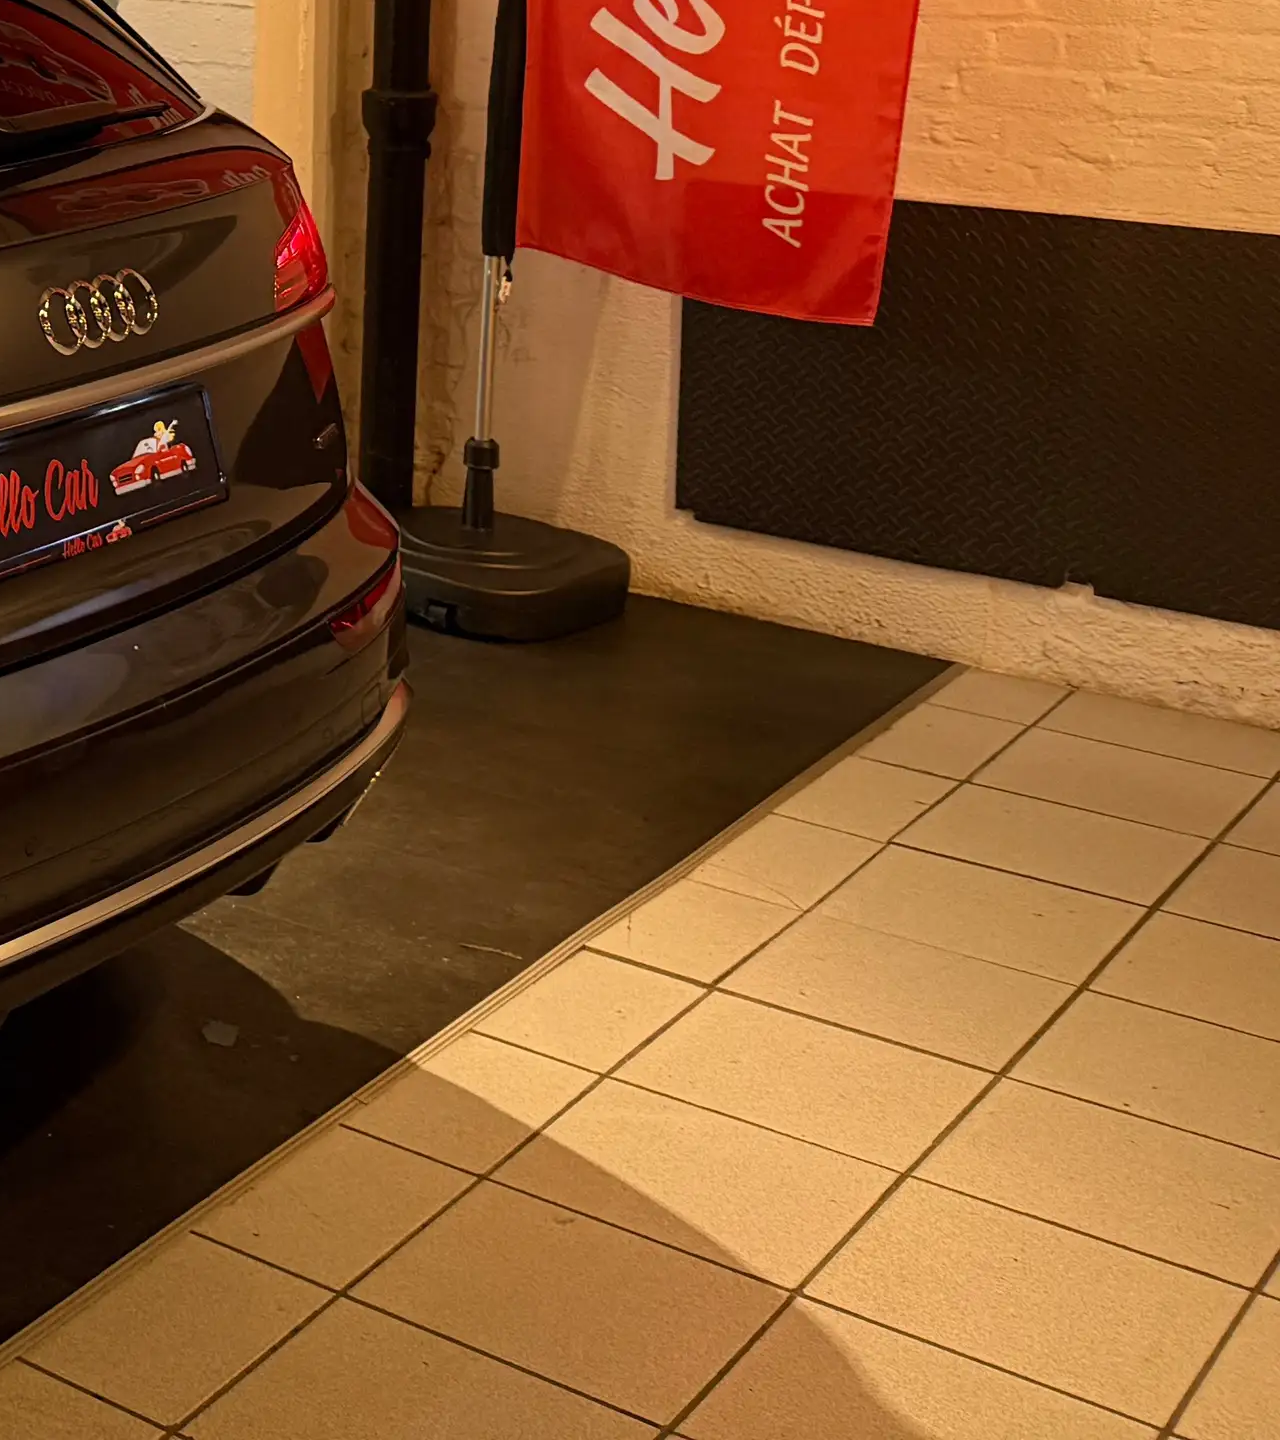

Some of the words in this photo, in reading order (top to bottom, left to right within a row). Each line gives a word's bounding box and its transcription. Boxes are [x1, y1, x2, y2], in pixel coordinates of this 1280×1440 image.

[762, 100, 815, 248] ACHAT
[44, 458, 99, 521] Car
[61, 538, 86, 560] Hello
[86, 531, 103, 551] Car
